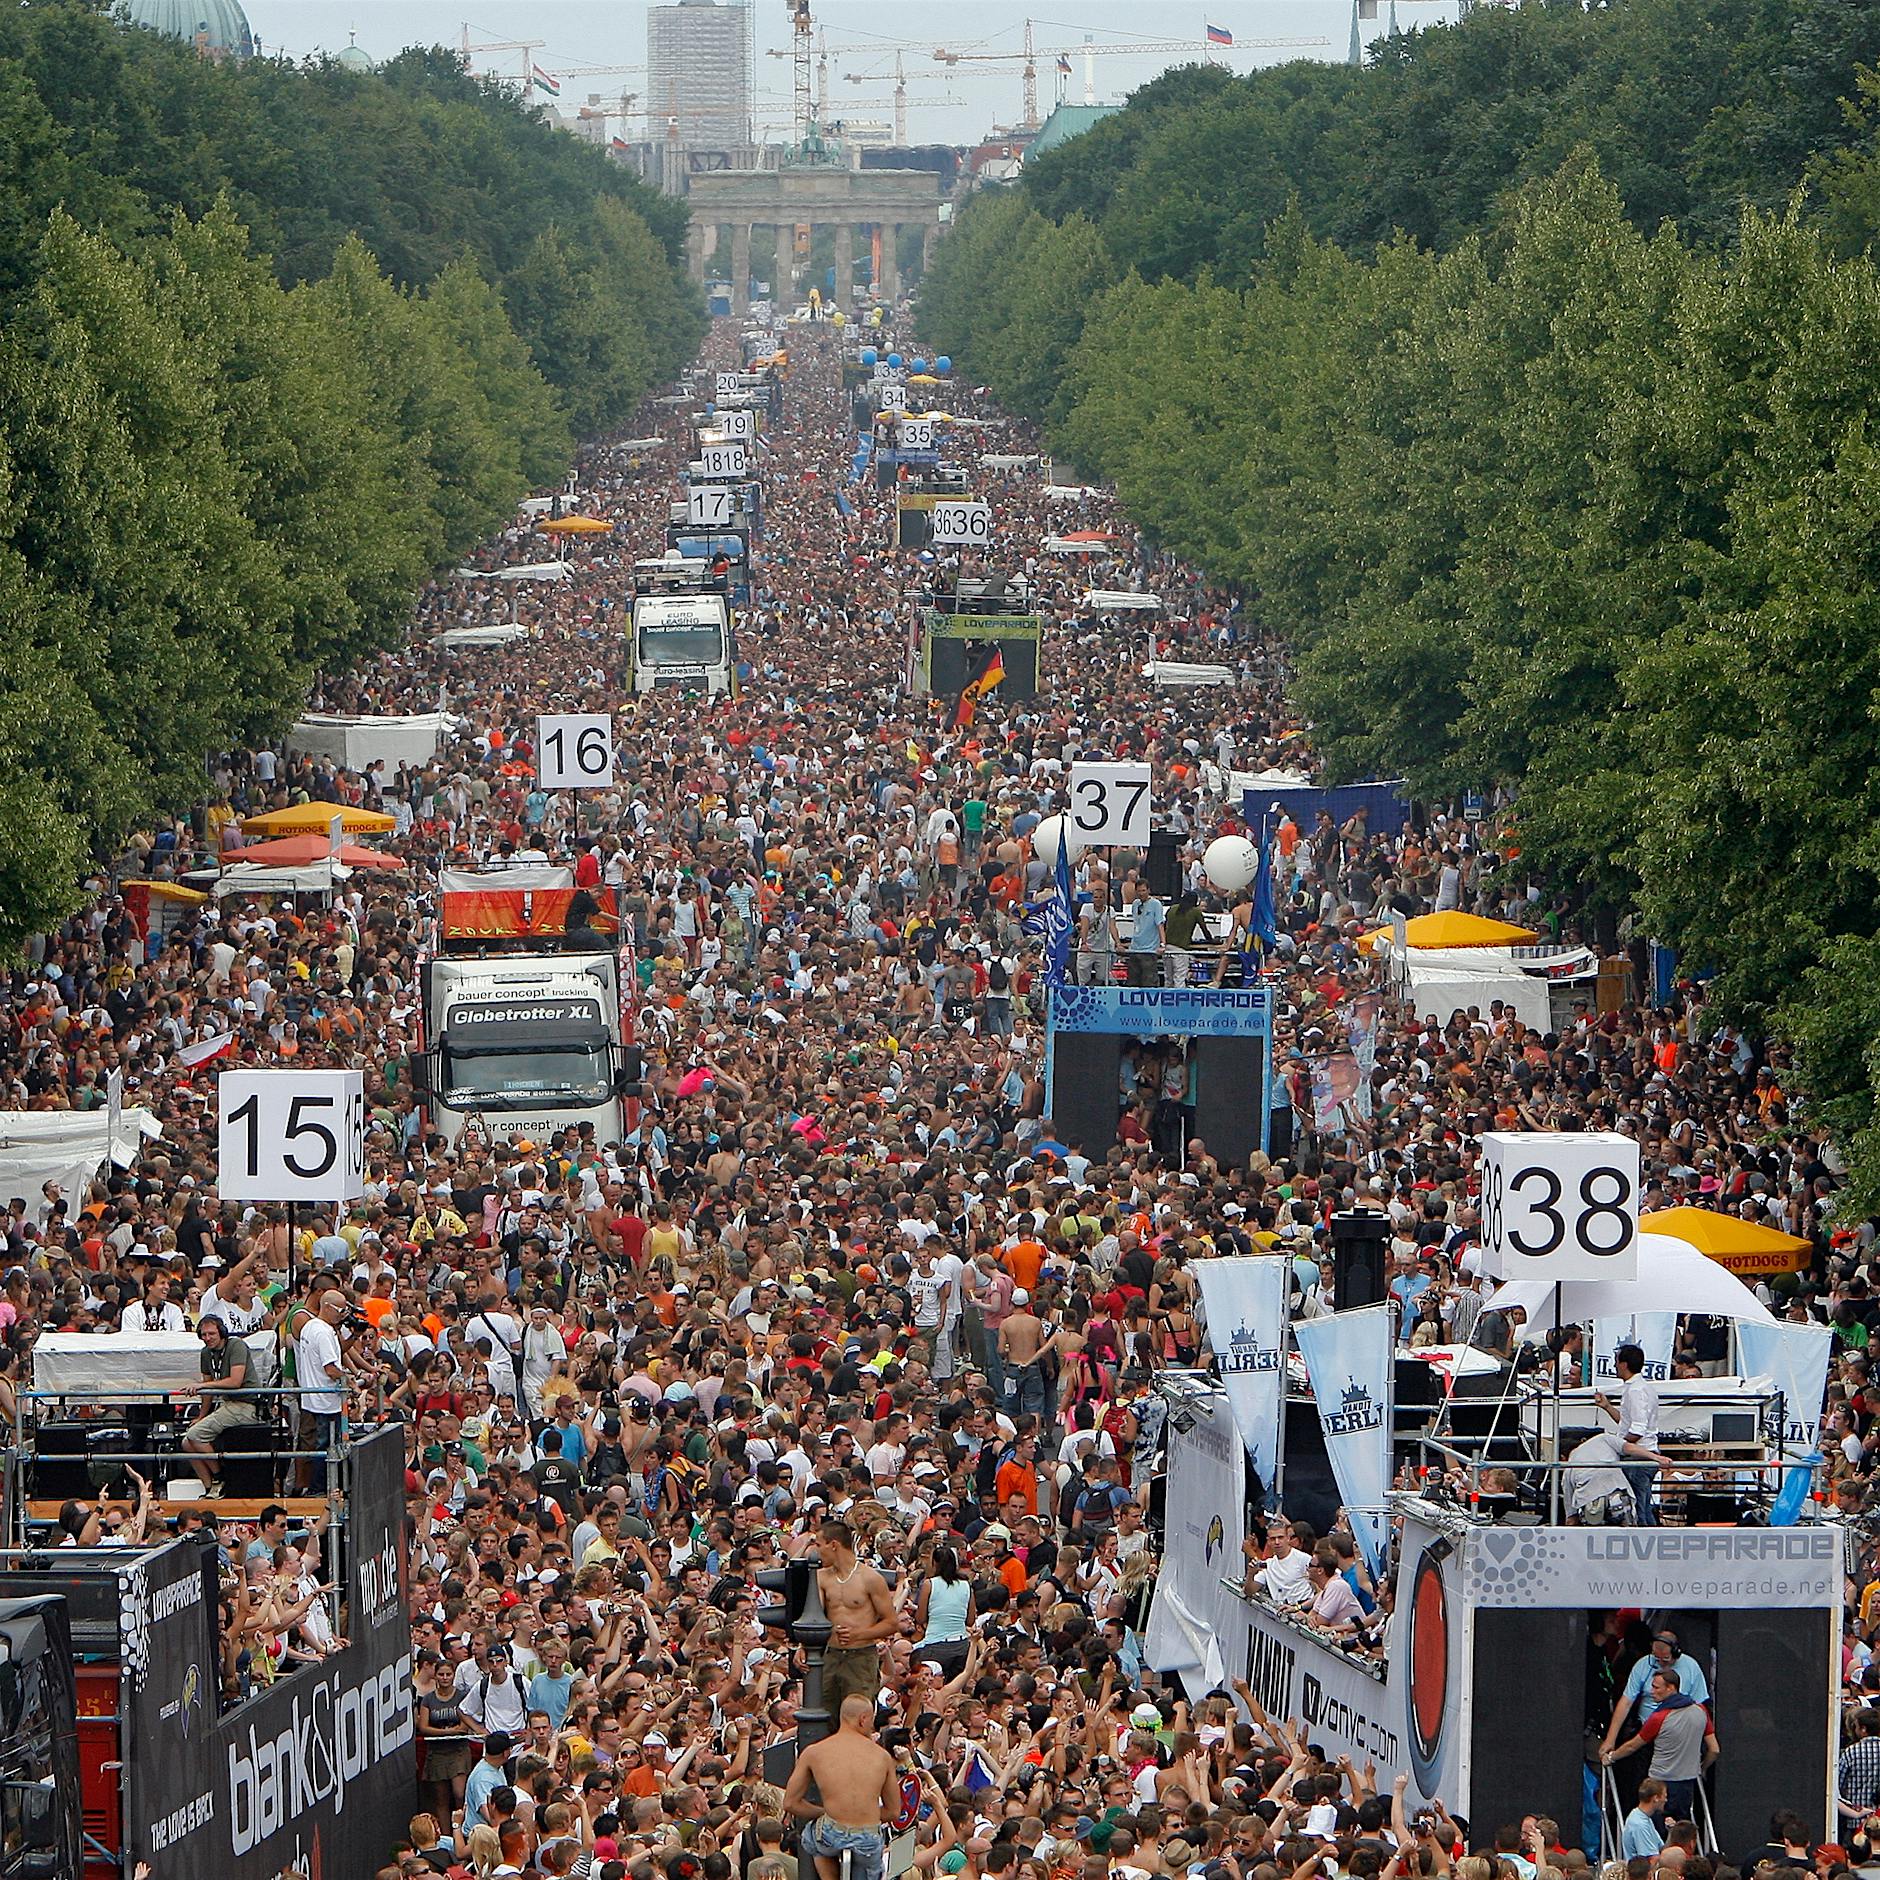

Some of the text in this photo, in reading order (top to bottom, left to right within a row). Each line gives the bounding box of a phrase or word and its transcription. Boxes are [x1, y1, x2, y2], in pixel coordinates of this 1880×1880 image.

[718, 376, 737, 390] 20
[884, 391, 905, 406] 34
[724, 416, 747, 434] 19
[905, 425, 930, 443] 35
[693, 493, 726, 518] 17
[935, 508, 951, 535] 36
[952, 509, 986, 536] 36
[964, 619, 1038, 629] LOVEPARADE
[545, 727, 608, 775] 16
[1074, 779, 1149, 832] 37
[278, 826, 325, 835] HOTDOGS
[341, 824, 377, 833] OTDOGS
[457, 991, 492, 1001] bauer
[552, 988, 589, 997] trucking
[1119, 991, 1266, 1008] LOVEPARADE
[454, 1005, 593, 1024] Globetrotter XL
[1119, 1016, 1266, 1030] www.loveparade.net
[227, 1094, 337, 1179] 15
[344, 1093, 362, 1176] 15
[466, 1122, 498, 1133] auer
[501, 1119, 551, 1133] concept
[1482, 1157, 1502, 1253] 38
[1507, 1166, 1634, 1257] 38
[1723, 1255, 1789, 1268] HOTDOGS
[1342, 1401, 1372, 1414] VANDIT
[1586, 1534, 1834, 1561] LOVEPARADE
[152, 1569, 202, 1623] LOVEPARADE
[1588, 1576, 1835, 1599] www.loveparade.net
[228, 1652, 414, 1857] blank&jones
[150, 1818, 167, 1853] THE
[167, 1806, 187, 1844] LOVE
